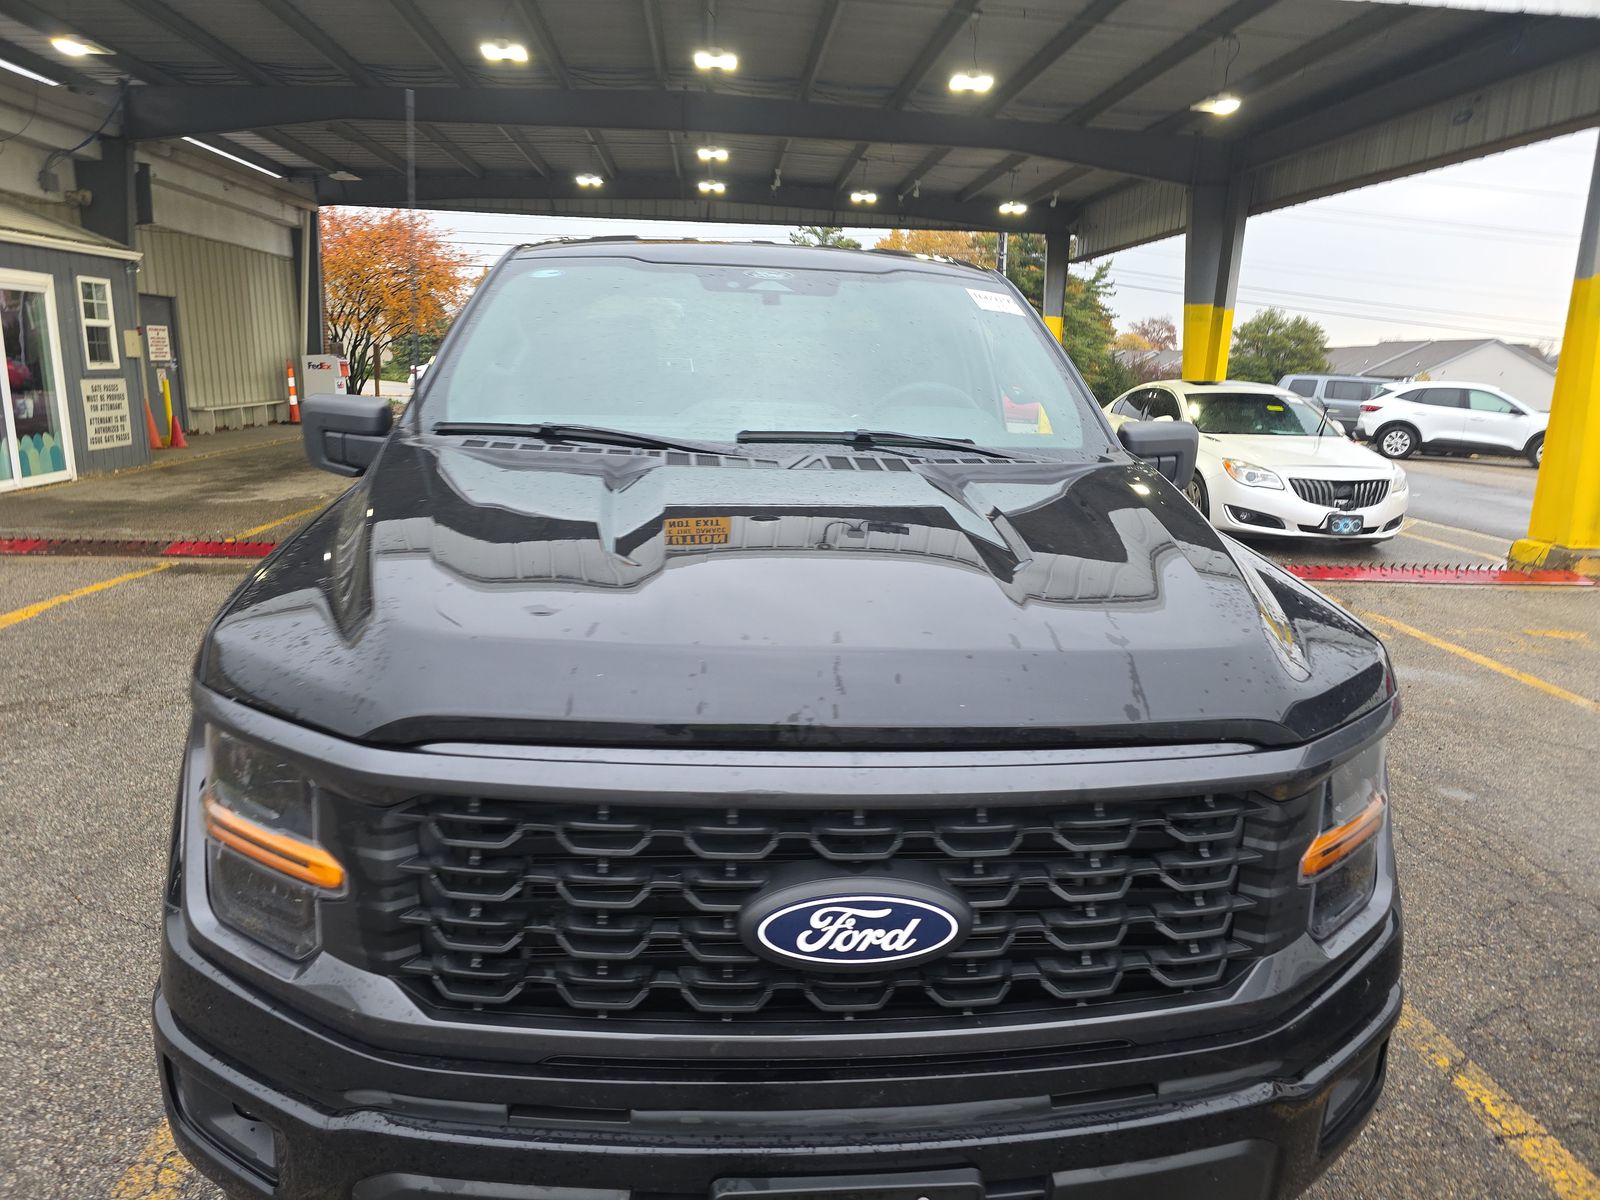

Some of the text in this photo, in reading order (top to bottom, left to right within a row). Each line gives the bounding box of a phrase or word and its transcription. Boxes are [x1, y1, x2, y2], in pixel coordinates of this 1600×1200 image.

[307, 361, 332, 370] FedEx
[103, 384, 119, 393] PASSES
[86, 394, 98, 403] MUST
[106, 393, 125, 401] PROVIDED
[90, 404, 98, 412] FOR
[90, 416, 113, 425] ATTENDANT
[95, 424, 125, 434] AUTHORIZED TO
[104, 434, 115, 443] GATE
[116, 433, 130, 441] PASSES
[796, 906, 922, 953] Ford
